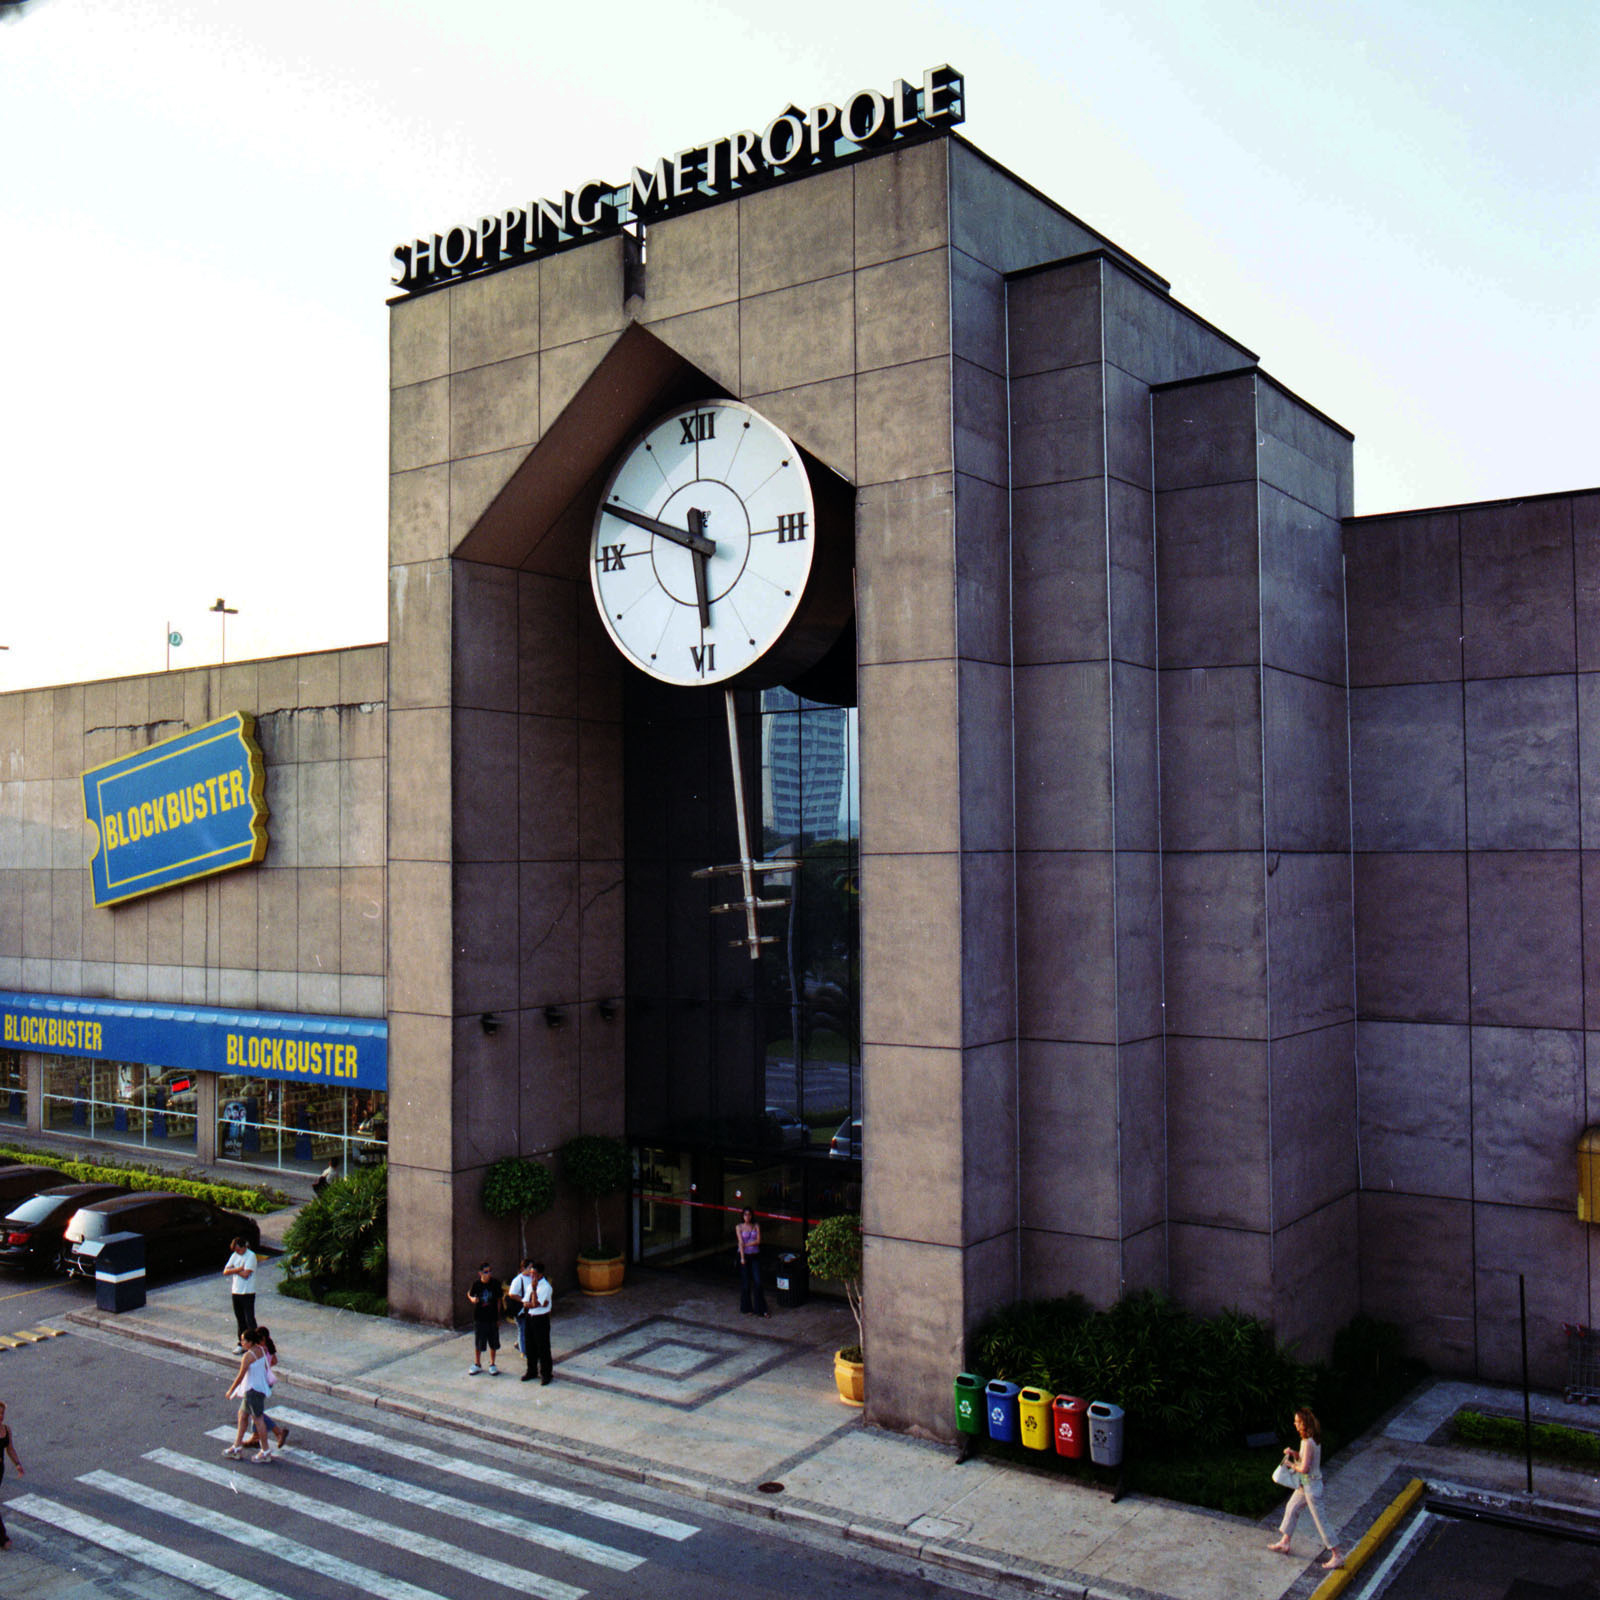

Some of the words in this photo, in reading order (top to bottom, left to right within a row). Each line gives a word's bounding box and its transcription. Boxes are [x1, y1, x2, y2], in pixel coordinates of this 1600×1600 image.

[389, 179, 603, 285] SHOPPING
[628, 63, 955, 211] METRÓPOLE
[679, 412, 716, 445] XII
[777, 512, 806, 543] III
[602, 544, 626, 572] IX
[690, 644, 716, 672] VI
[105, 769, 245, 850] BLOCKBUSTER
[4, 1014, 102, 1051] BLOCKBUSTER
[226, 1034, 358, 1079] BLOCKBUSTER
